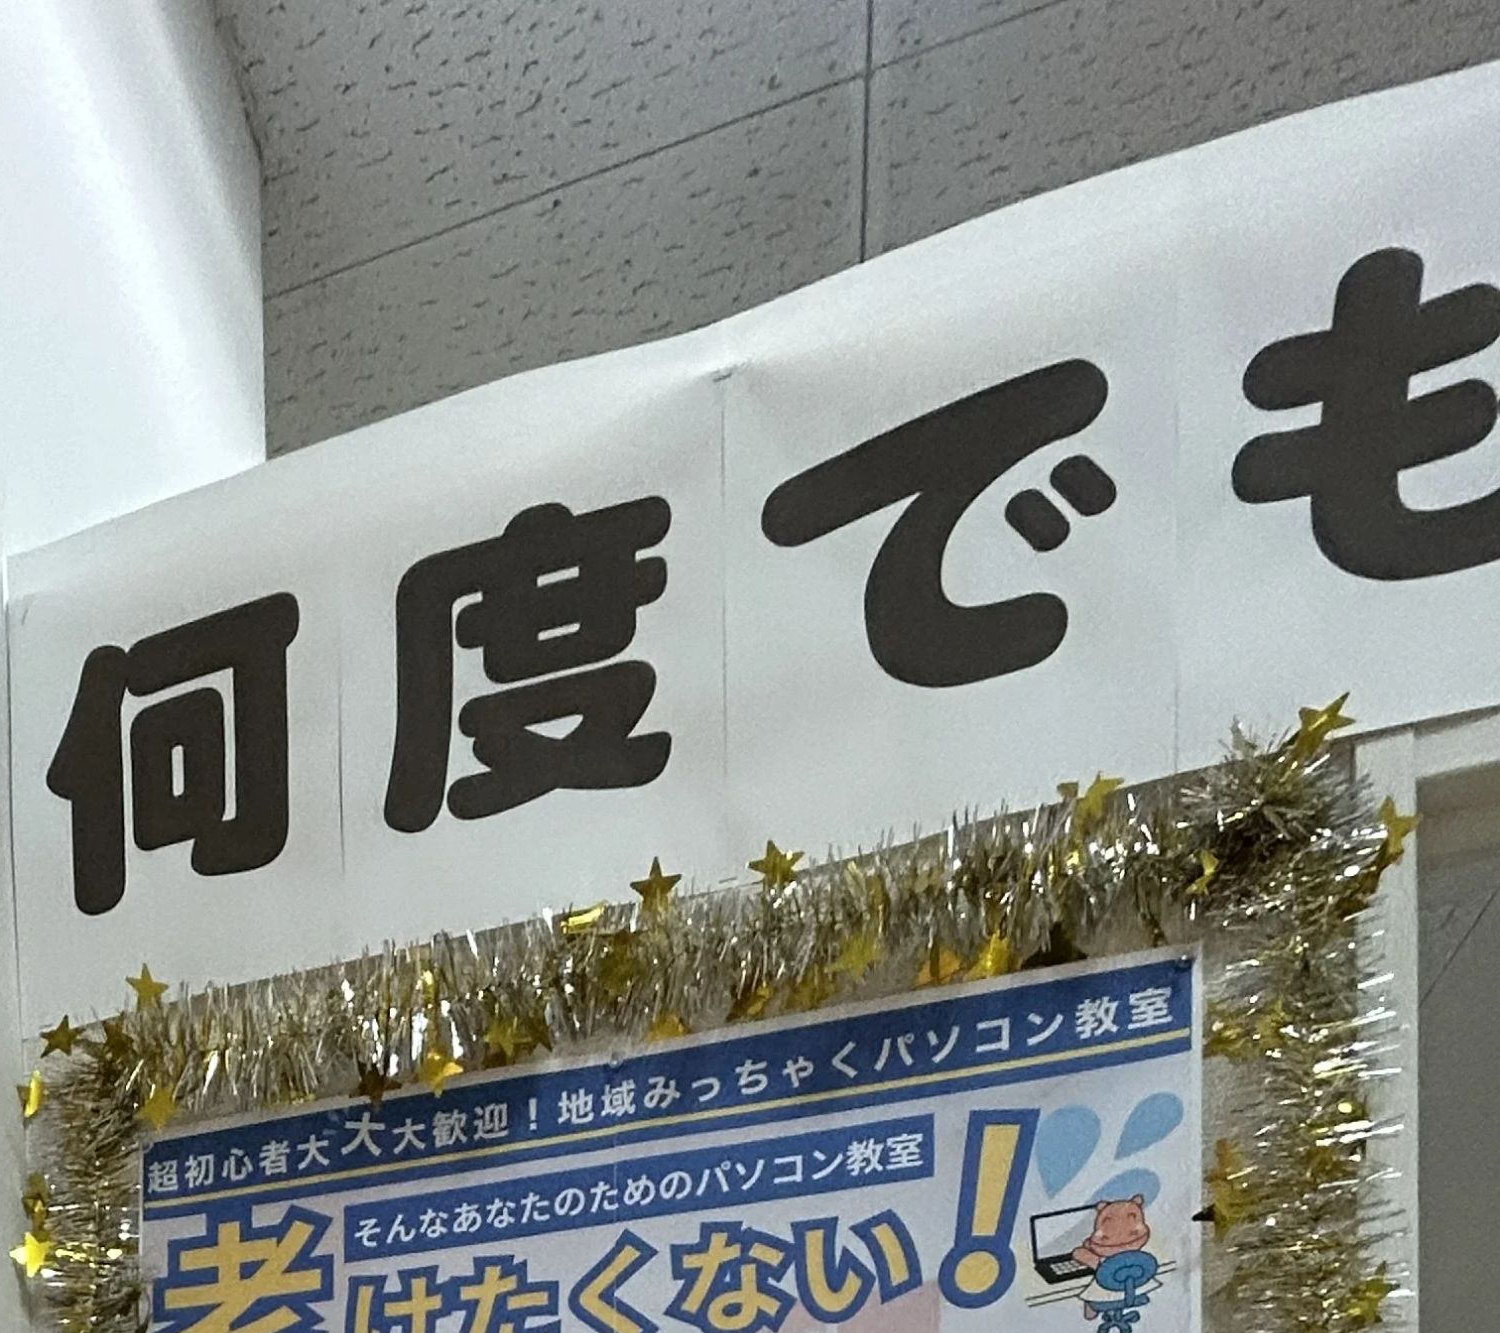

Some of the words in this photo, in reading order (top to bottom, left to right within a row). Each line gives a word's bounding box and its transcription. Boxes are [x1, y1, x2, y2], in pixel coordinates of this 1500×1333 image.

[45, 246, 1500, 916] 何度でも
[354, 1132, 925, 1249] そんなあなたのためのパソコン教室
